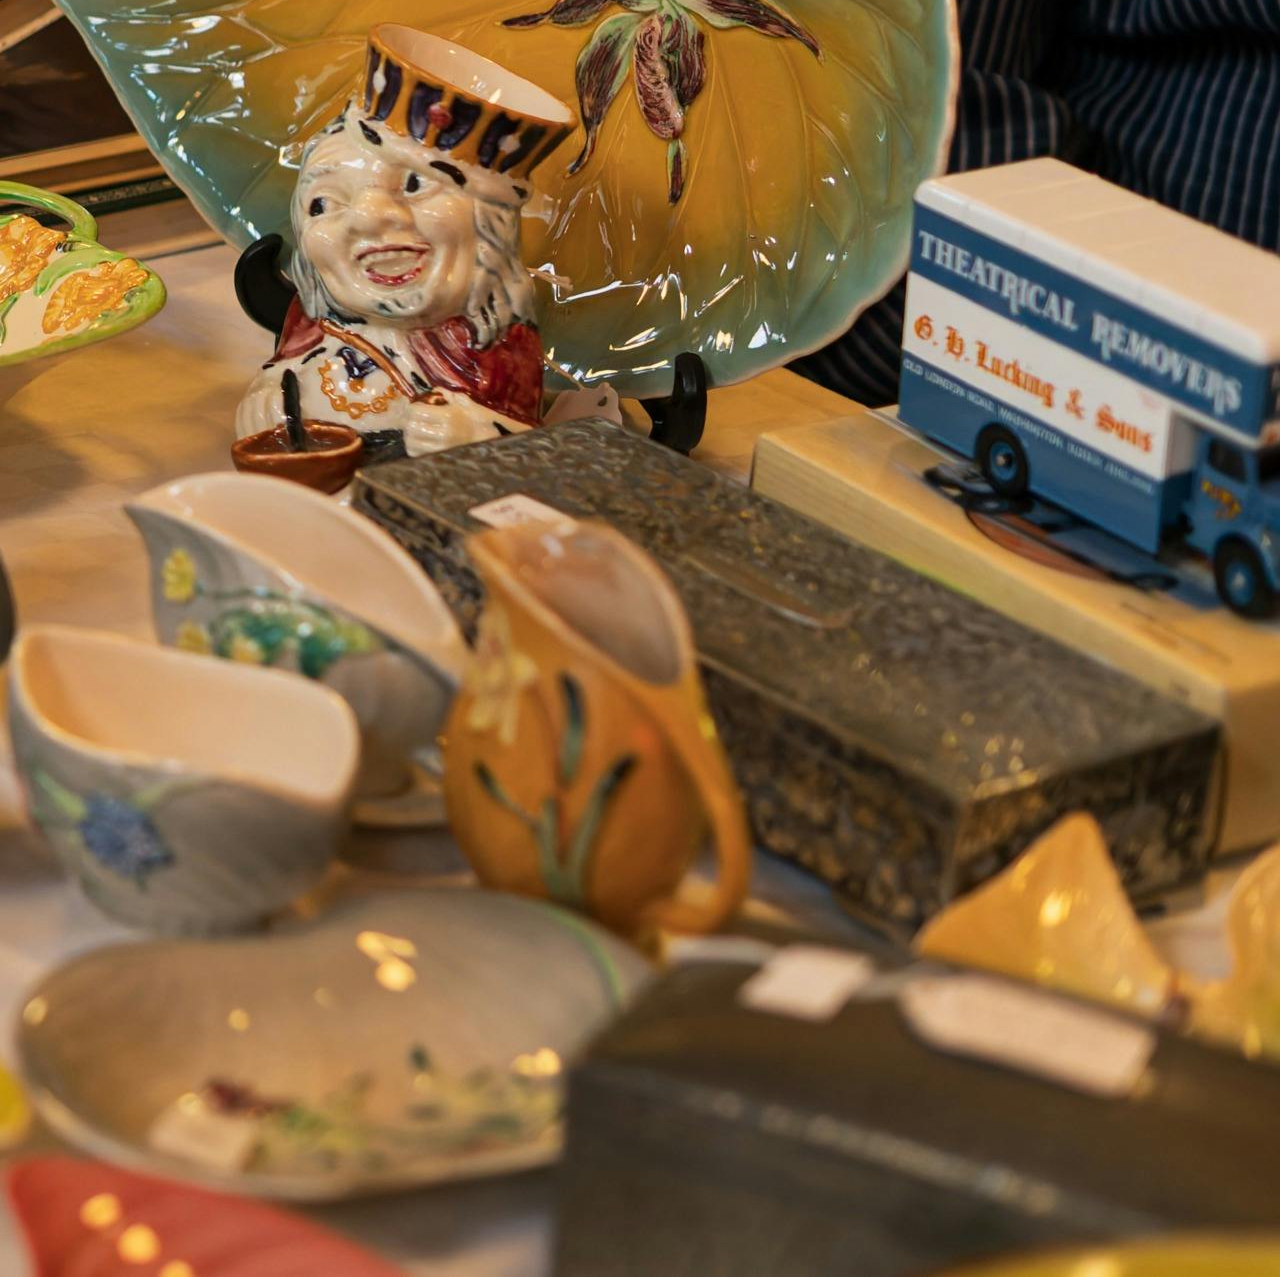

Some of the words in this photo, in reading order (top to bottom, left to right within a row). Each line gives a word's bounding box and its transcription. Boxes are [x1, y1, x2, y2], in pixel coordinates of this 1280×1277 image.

[918, 229, 1080, 332] THEATRICAL
[1090, 309, 1242, 417] REMOVERS
[1064, 388, 1086, 420] &
[1095, 403, 1155, 453] Sons
